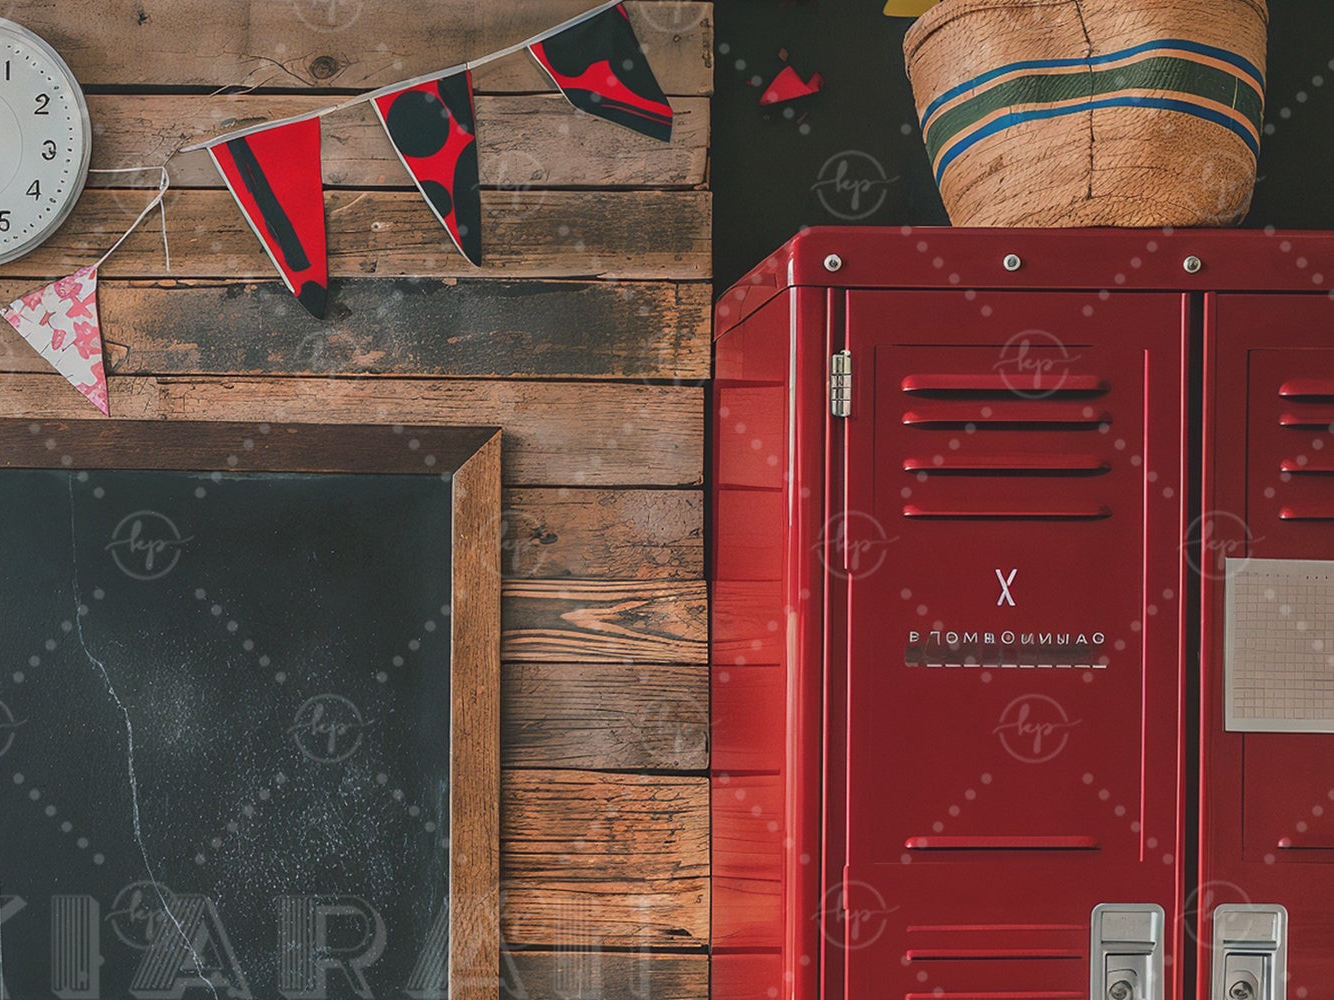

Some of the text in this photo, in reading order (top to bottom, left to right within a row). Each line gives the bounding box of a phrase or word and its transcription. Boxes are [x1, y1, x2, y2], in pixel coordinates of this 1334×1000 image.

[4, 60, 11, 81] 1
[34, 93, 51, 115] 2
[41, 140, 57, 160] 3
[26, 179, 41, 201] 4
[995, 568, 1017, 606] X
